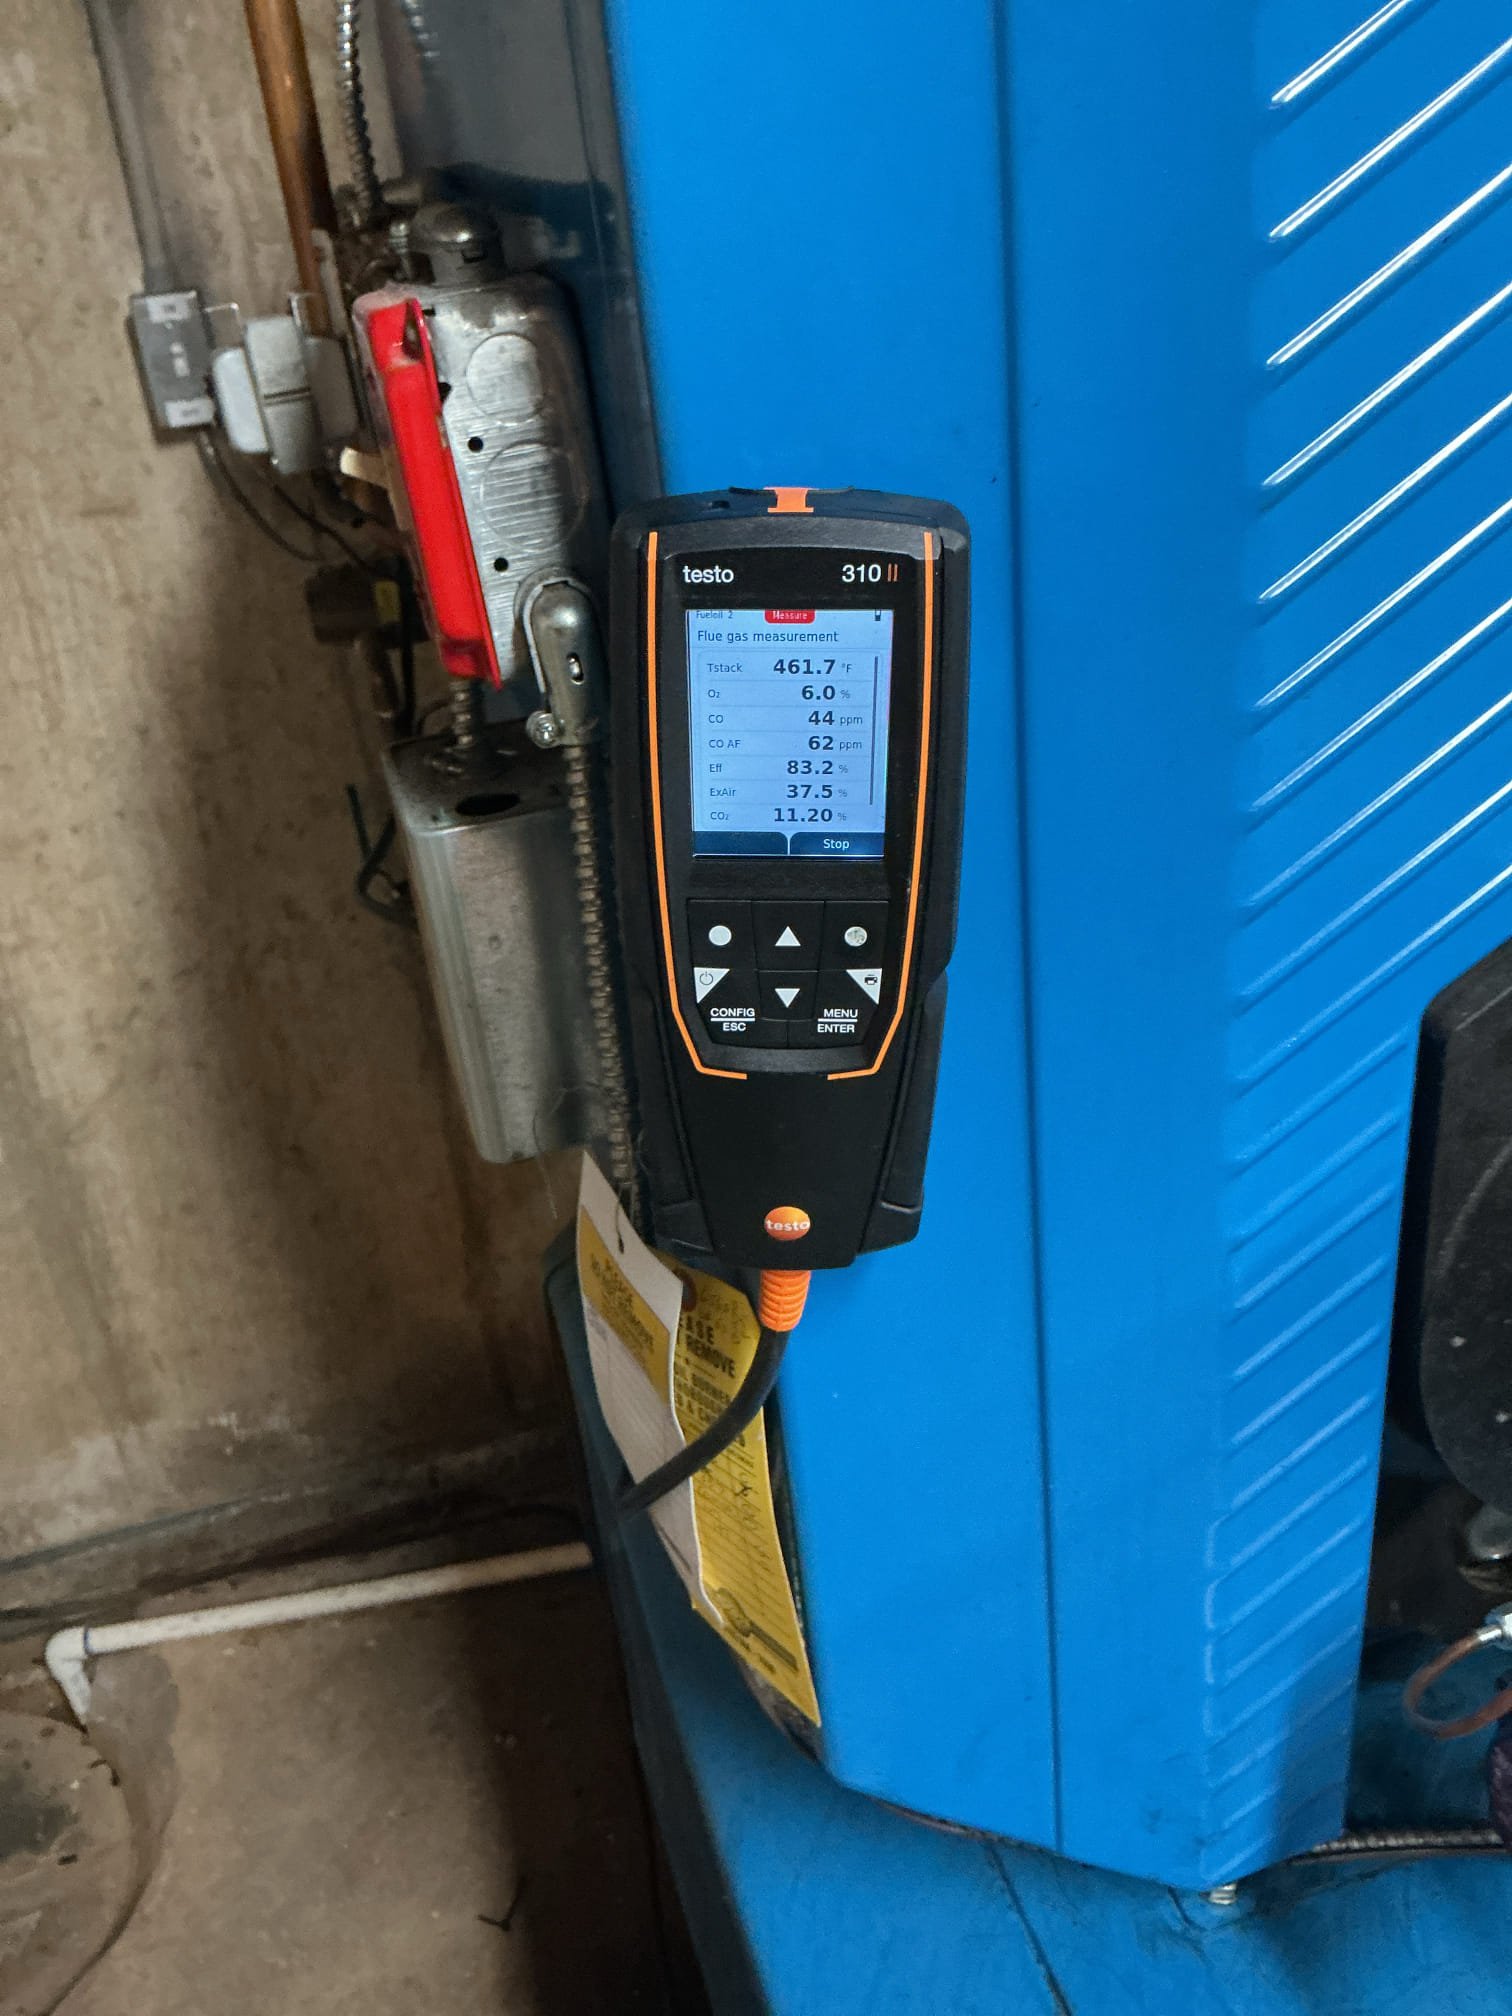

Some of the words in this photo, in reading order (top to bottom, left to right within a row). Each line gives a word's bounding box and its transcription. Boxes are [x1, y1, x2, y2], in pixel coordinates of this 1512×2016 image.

[682, 565, 735, 584] testo
[841, 564, 882, 583] 310
[772, 610, 808, 620] Measure
[697, 630, 722, 642] Flue
[727, 633, 748, 644] gas
[753, 631, 839, 642] measurement
[707, 662, 742, 673] Tstack
[773, 658, 836, 675] 461.7
[801, 685, 835, 700] 6.0
[840, 690, 850, 699] %
[708, 714, 724, 724] CO
[808, 710, 835, 726] 44
[840, 714, 863, 726] ppm
[708, 739, 724, 749] CO
[727, 739, 741, 749] AF
[808, 736, 834, 751] 62
[839, 740, 862, 752] ppm
[709, 762, 723, 773] Eff
[786, 760, 833, 775] 83.2
[838, 764, 849, 774] %
[710, 787, 736, 797] ExAir
[786, 784, 833, 799] 37.5
[838, 789, 847, 798] %
[773, 808, 833, 823] 11.20
[837, 813, 847, 822] %
[823, 838, 849, 850] Stop
[710, 1007, 755, 1017] CONFIG
[823, 1008, 858, 1018] MENU
[722, 1022, 746, 1032] ESC
[817, 1023, 855, 1033] ENTER
[766, 1219, 810, 1231] testo
